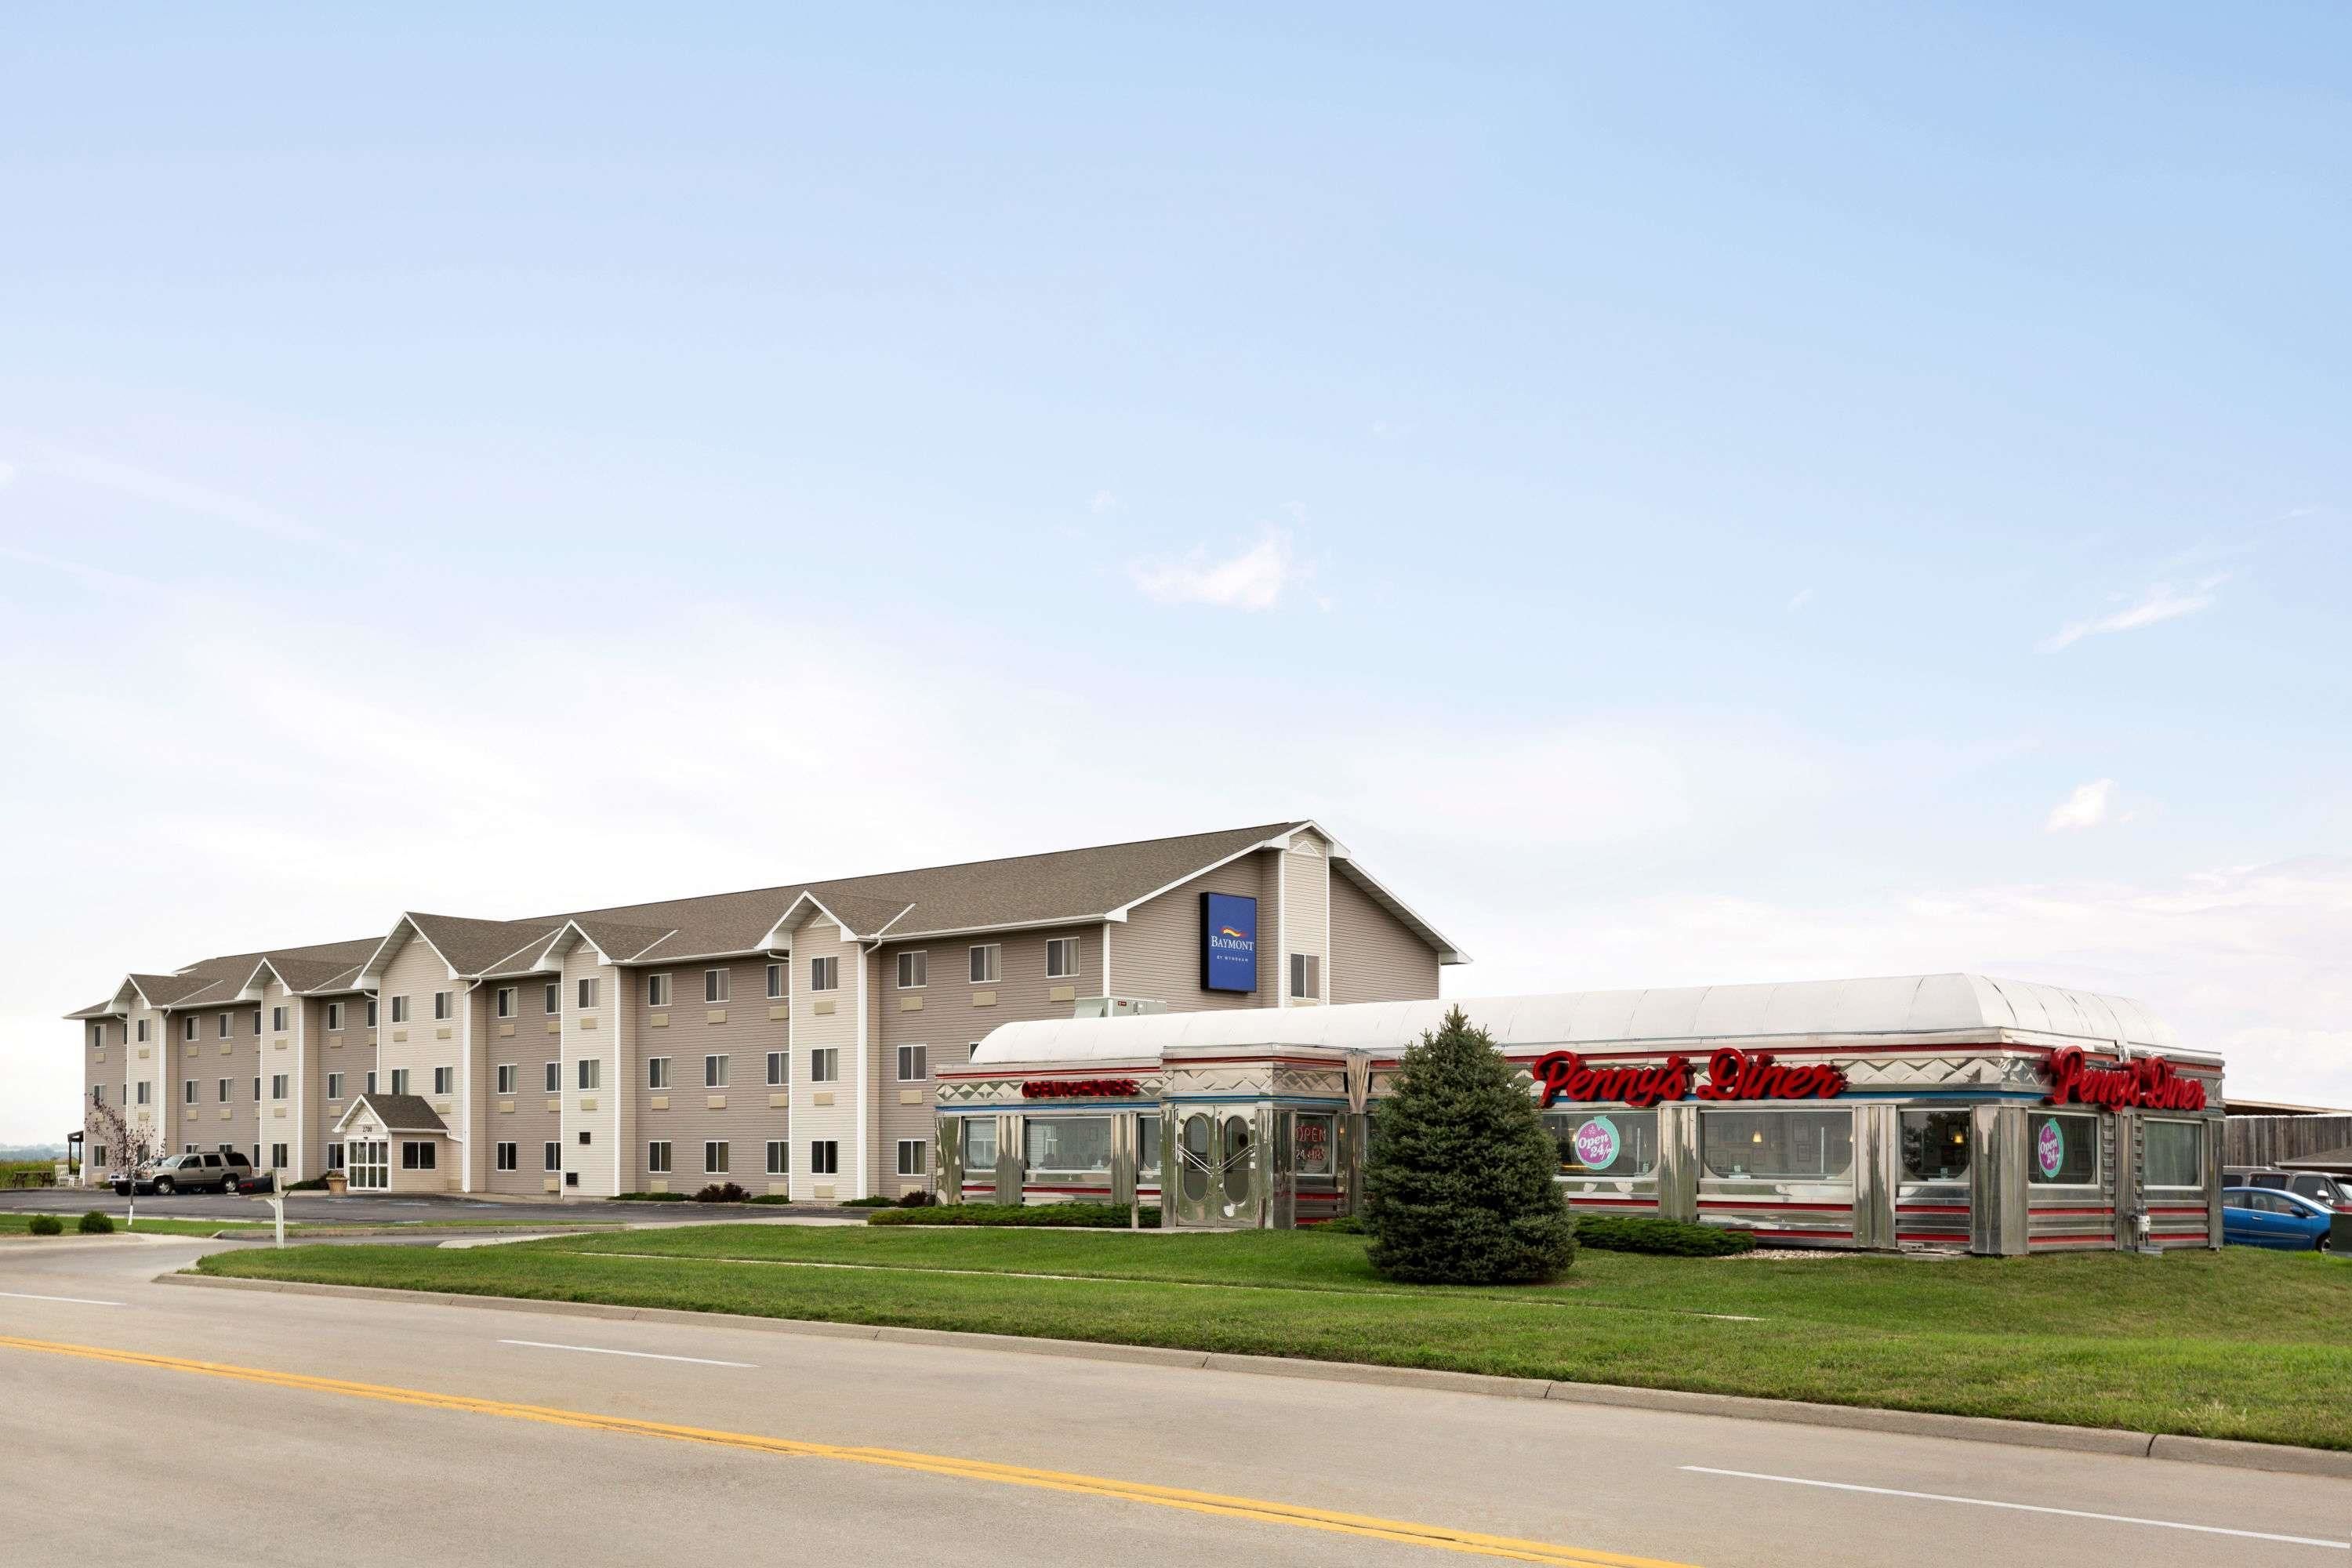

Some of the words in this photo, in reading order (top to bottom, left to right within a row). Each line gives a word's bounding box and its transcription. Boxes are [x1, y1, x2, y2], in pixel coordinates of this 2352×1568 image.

[1210, 935, 1254, 951] BAYMONT
[1533, 1050, 1693, 1109] Penny's
[1696, 1047, 1848, 1099] Diner
[2048, 1045, 2142, 1112] Penny's
[2142, 1056, 2207, 1111] Diner
[1296, 1127, 1327, 1142] OPEN
[1578, 1134, 1609, 1149] Open
[2040, 1138, 2057, 1154] Open
